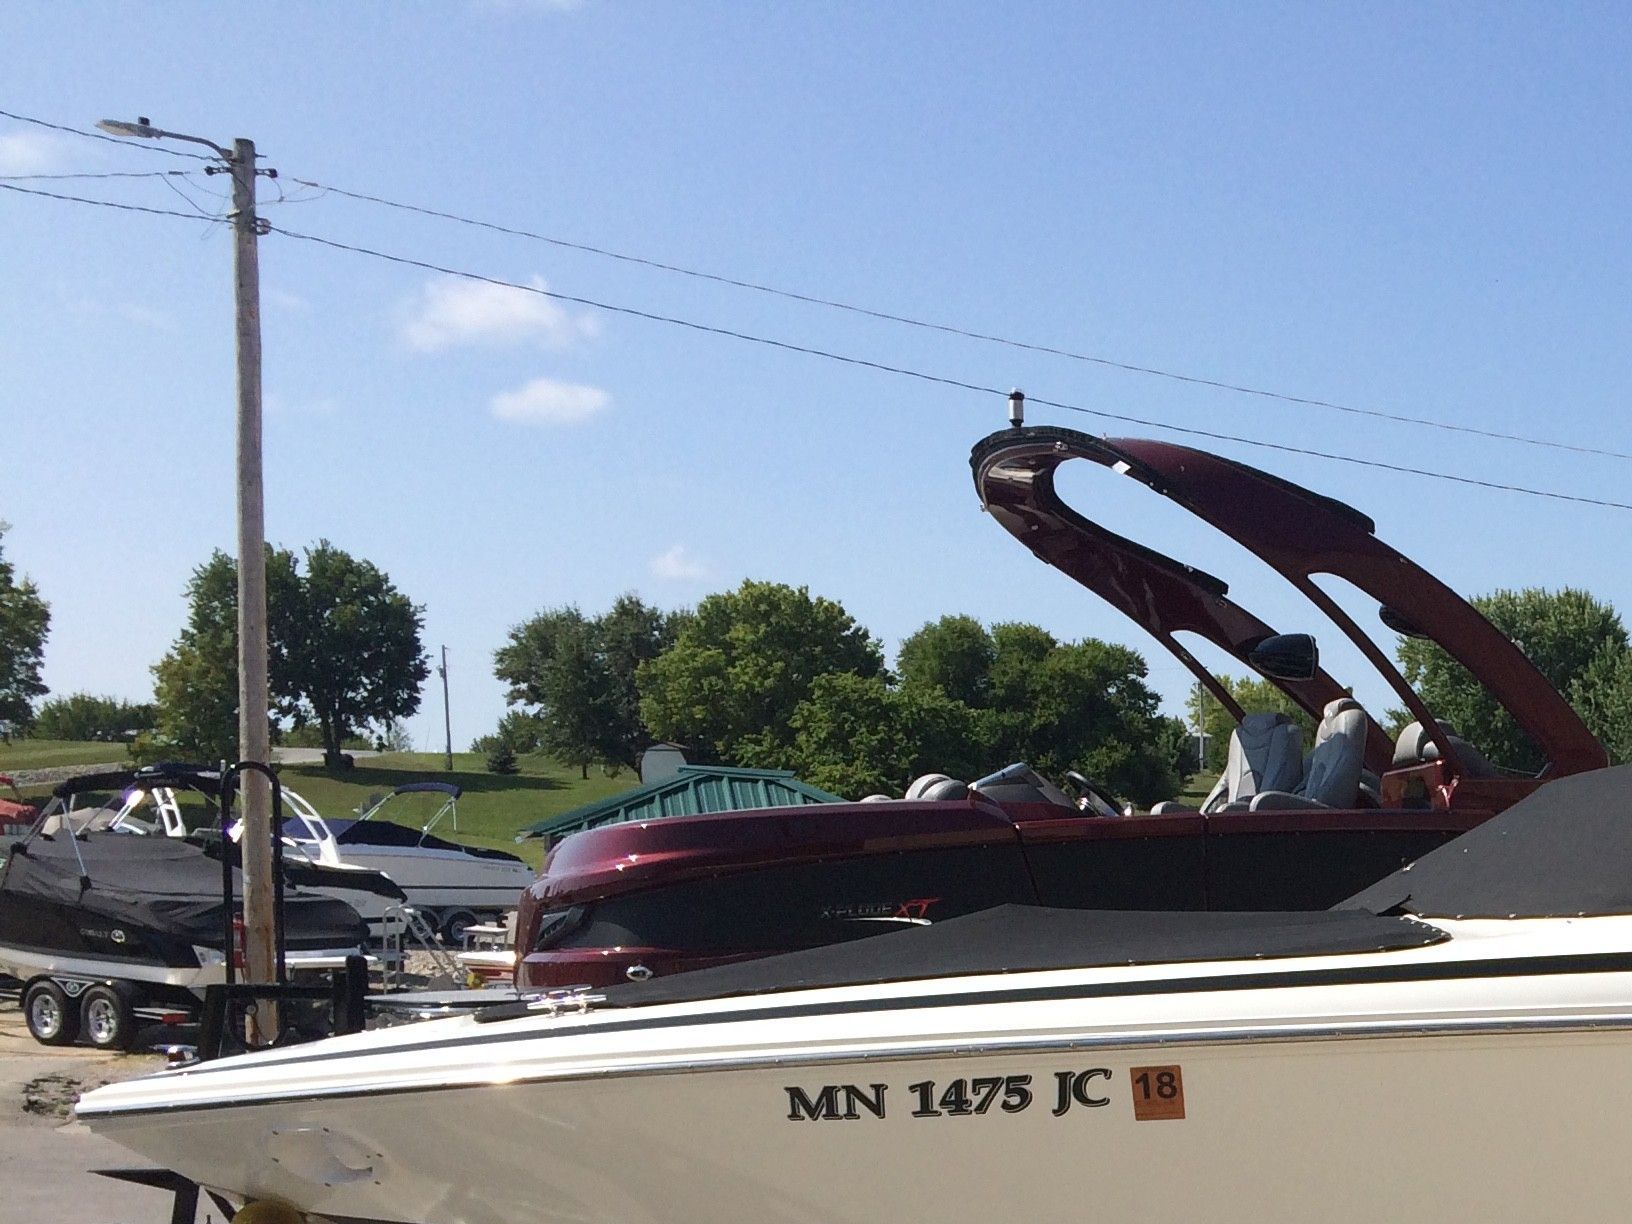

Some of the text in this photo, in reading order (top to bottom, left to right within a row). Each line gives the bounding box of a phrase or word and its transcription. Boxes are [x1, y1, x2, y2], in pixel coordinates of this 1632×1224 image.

[784, 1068, 1112, 1122] MN 1475 JC
[1134, 1071, 1178, 1100] 18
